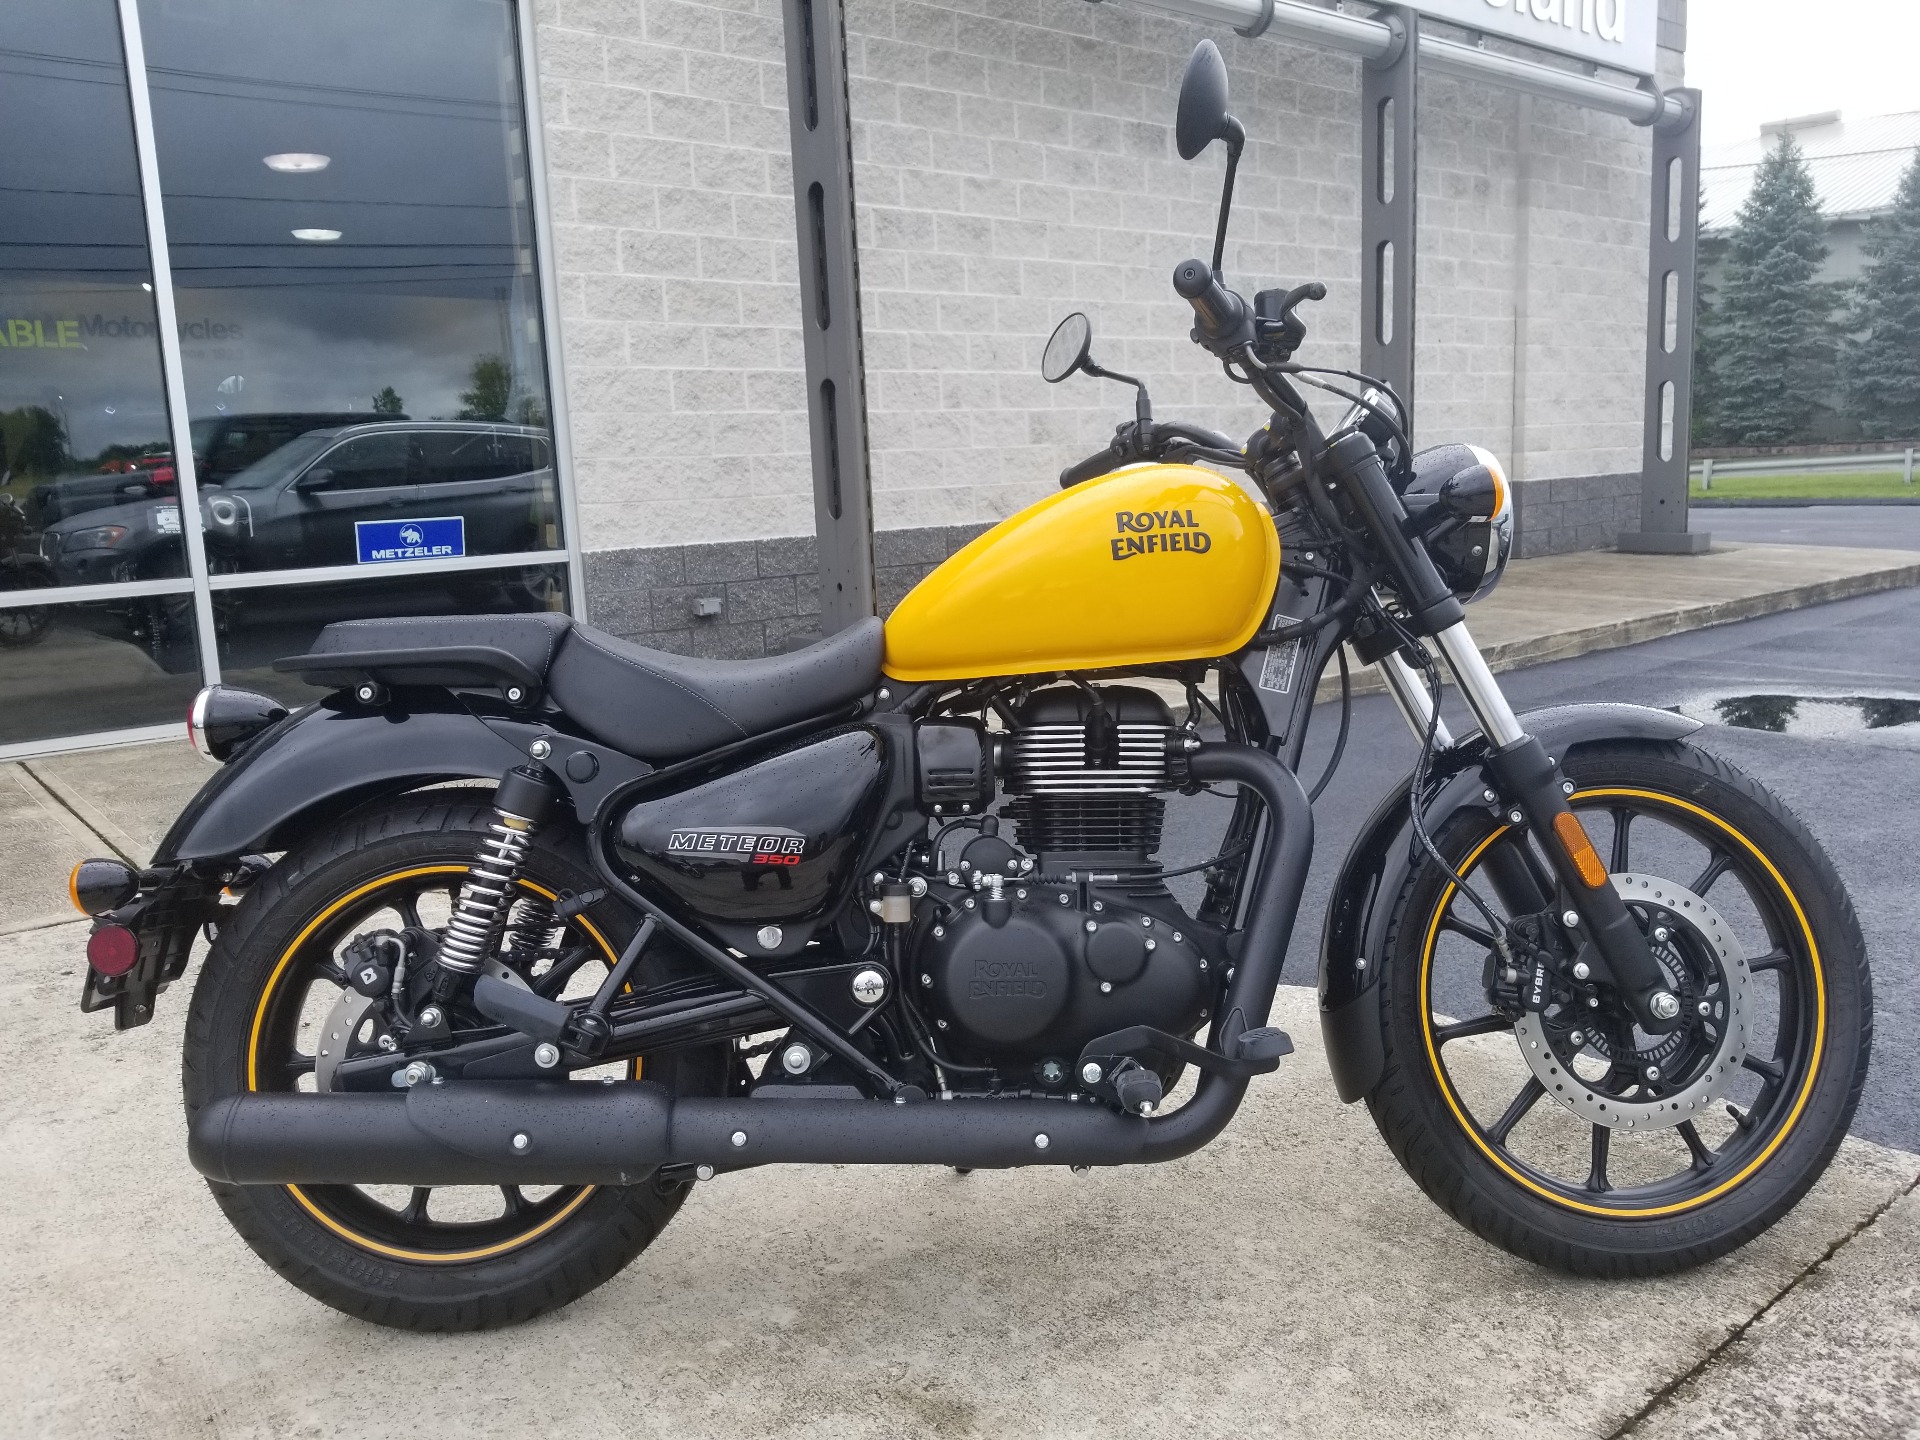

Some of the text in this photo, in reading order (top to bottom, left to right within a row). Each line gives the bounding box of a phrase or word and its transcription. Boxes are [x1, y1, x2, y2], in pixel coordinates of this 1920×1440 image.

[1116, 510, 1199, 533] ROYAL
[372, 545, 452, 559] METZELER
[1111, 532, 1211, 560] ENFIELD
[668, 834, 805, 853] METEOR
[753, 854, 800, 865] 350
[974, 959, 1038, 978] ROYAL
[969, 980, 1047, 999] ENFIELD
